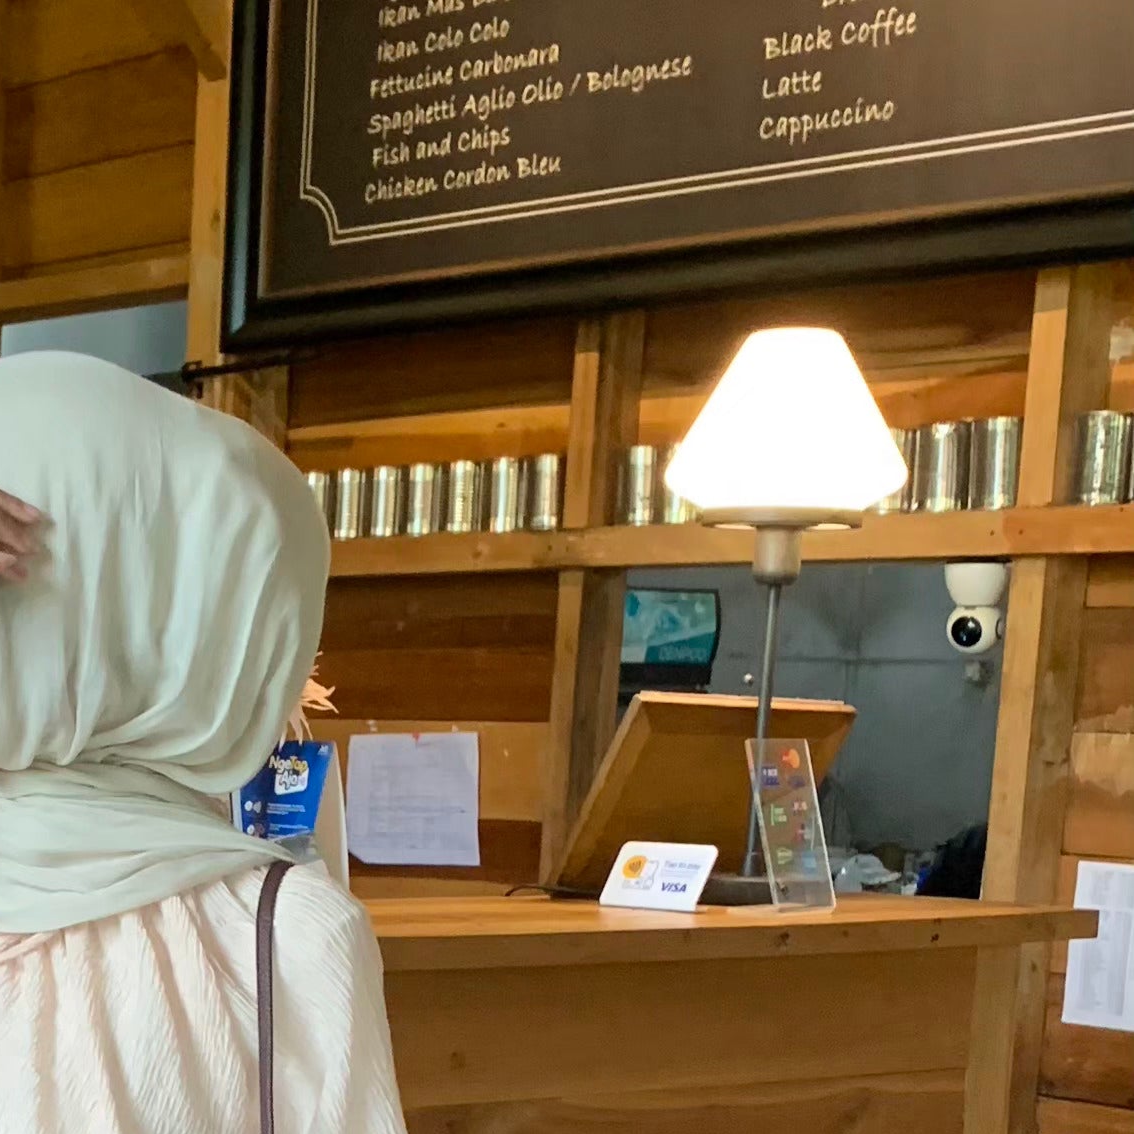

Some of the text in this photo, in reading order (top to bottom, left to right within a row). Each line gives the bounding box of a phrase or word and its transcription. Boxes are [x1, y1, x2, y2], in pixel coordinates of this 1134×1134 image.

[377, 16, 510, 63] Ikan Colo Colo
[763, 6, 917, 60] Black Coffee
[369, 44, 560, 99] Fettucine Carbonara
[762, 69, 823, 99] Latte
[367, 55, 692, 139] Spaghetti Aglio Olio / Bolognese
[759, 97, 895, 145] Cappuccino
[372, 124, 511, 168] Fish and Chips
[365, 153, 562, 204] Chicken Cordon Bleu
[661, 882, 687, 893] VISA
